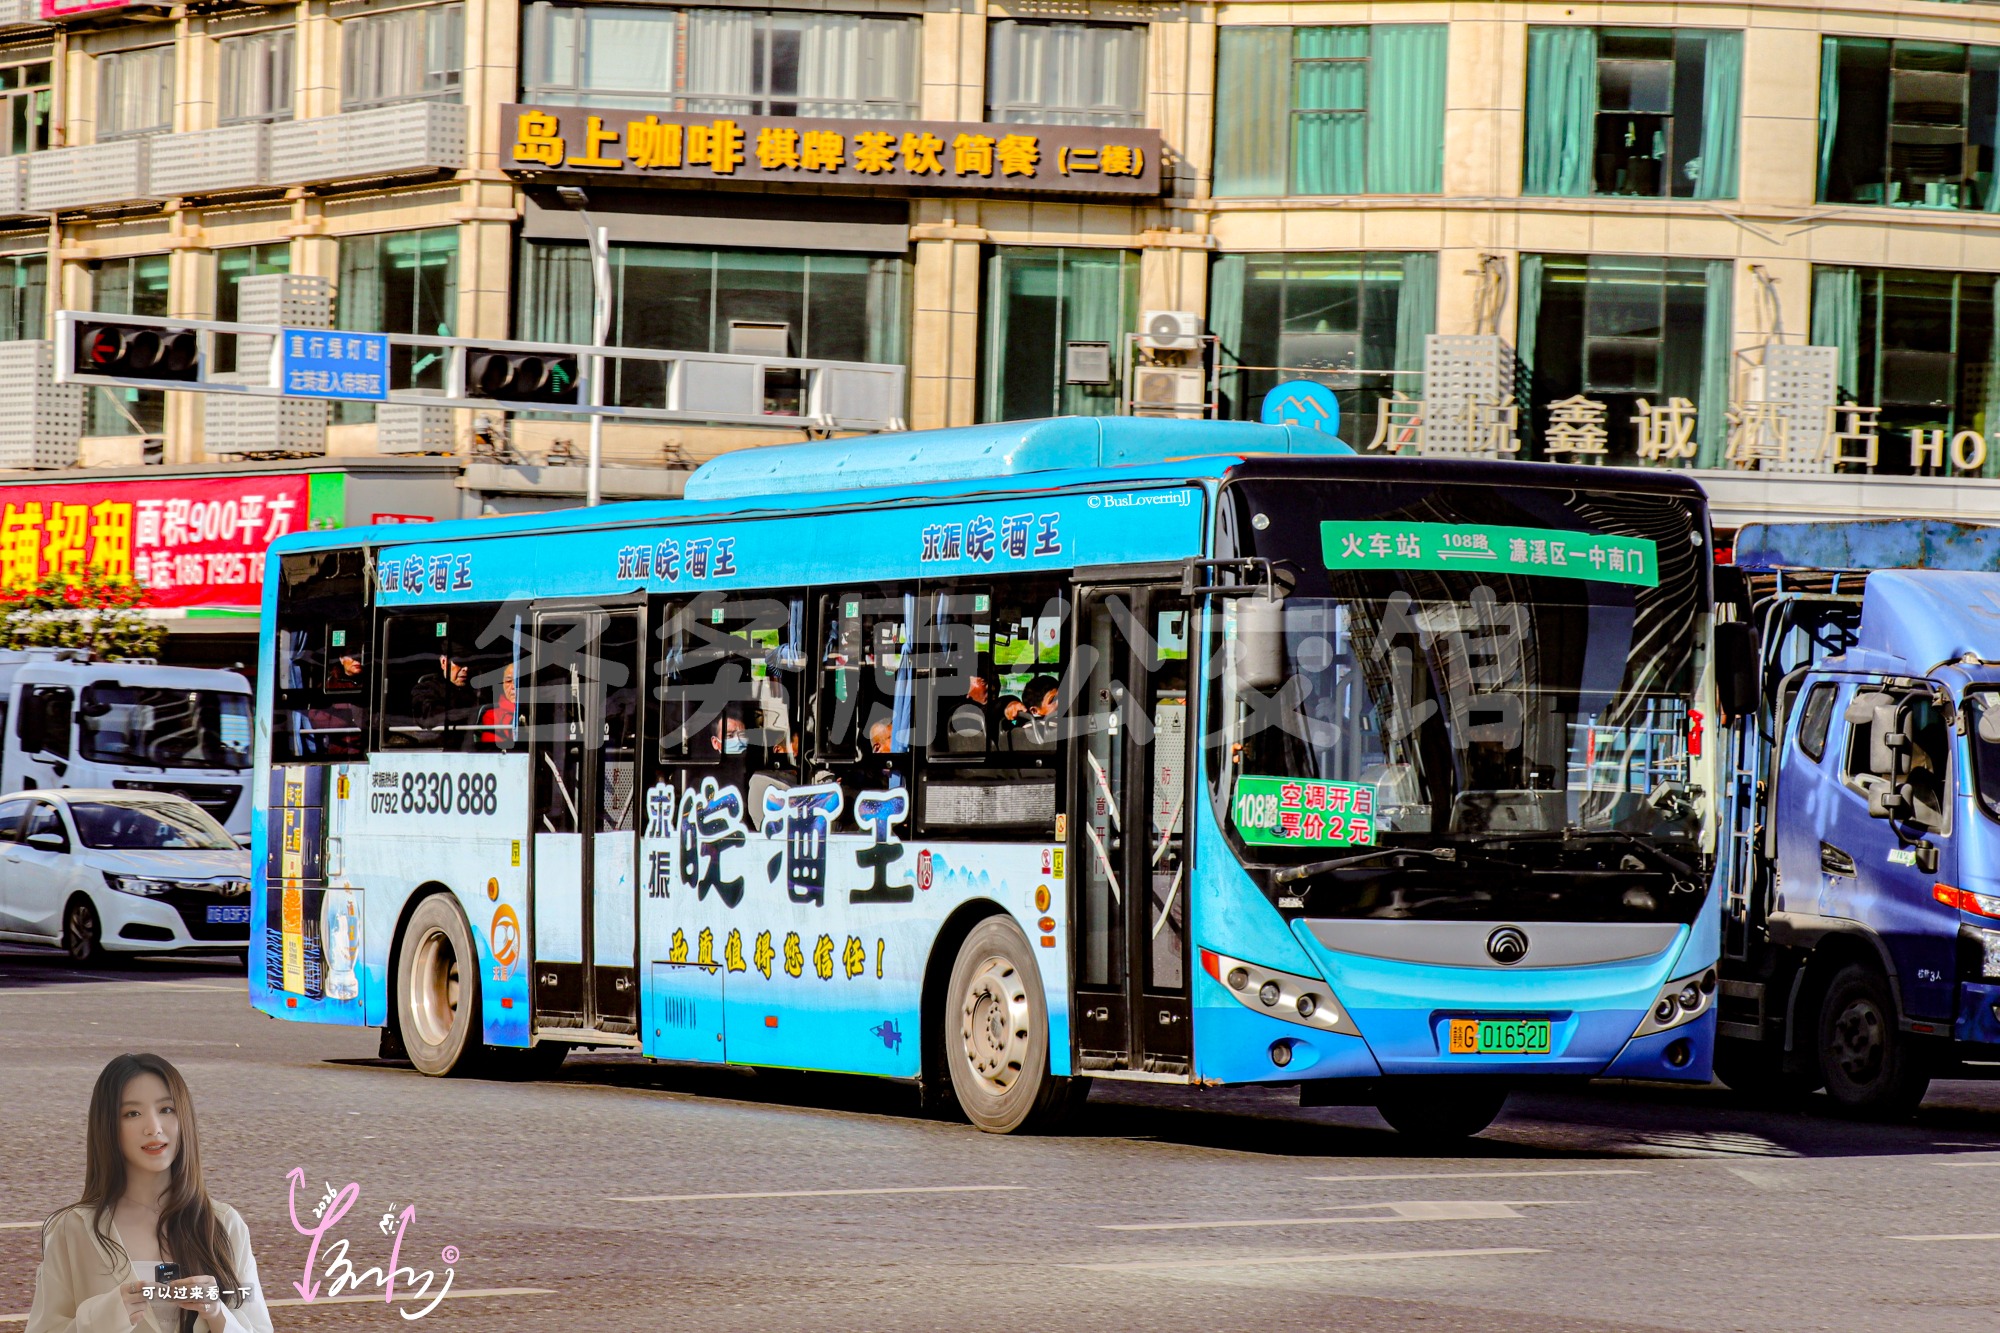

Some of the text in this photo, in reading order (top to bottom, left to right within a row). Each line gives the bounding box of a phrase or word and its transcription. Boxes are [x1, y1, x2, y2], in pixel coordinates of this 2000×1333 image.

[513, 110, 745, 174] 岛上咖啡
[755, 126, 845, 172] 棋牌
[853, 131, 945, 176] 茶饮
[951, 132, 1040, 178] 简餐
[290, 336, 380, 361] 直行绿灯时
[1911, 429, 2000, 470] HO
[135, 493, 295, 548] 面积900平方
[1341, 533, 1644, 574] 火车站 108路 濂溪区一中南门
[371, 772, 497, 815] 0792 8330 888
[1238, 794, 1278, 828] 108路
[1280, 783, 1373, 815] 空调开启
[680, 779, 914, 909] 皖酒王
[1280, 812, 1371, 844] 票价2元
